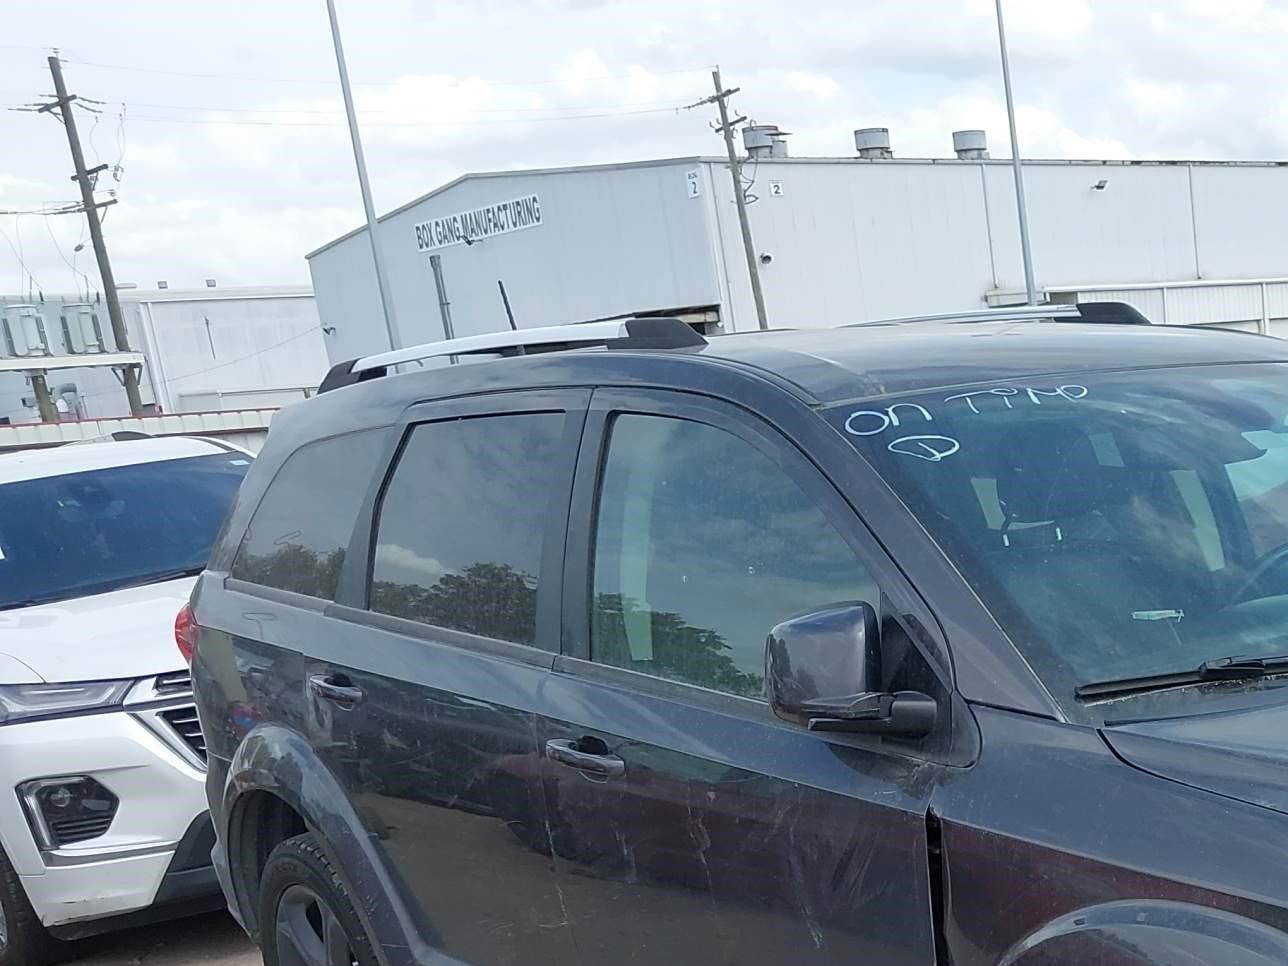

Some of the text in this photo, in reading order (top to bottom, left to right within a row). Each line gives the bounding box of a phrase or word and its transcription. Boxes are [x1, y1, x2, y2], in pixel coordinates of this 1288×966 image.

[773, 184, 781, 194] 2
[415, 196, 541, 249] BOX GANG MANUFACTURING
